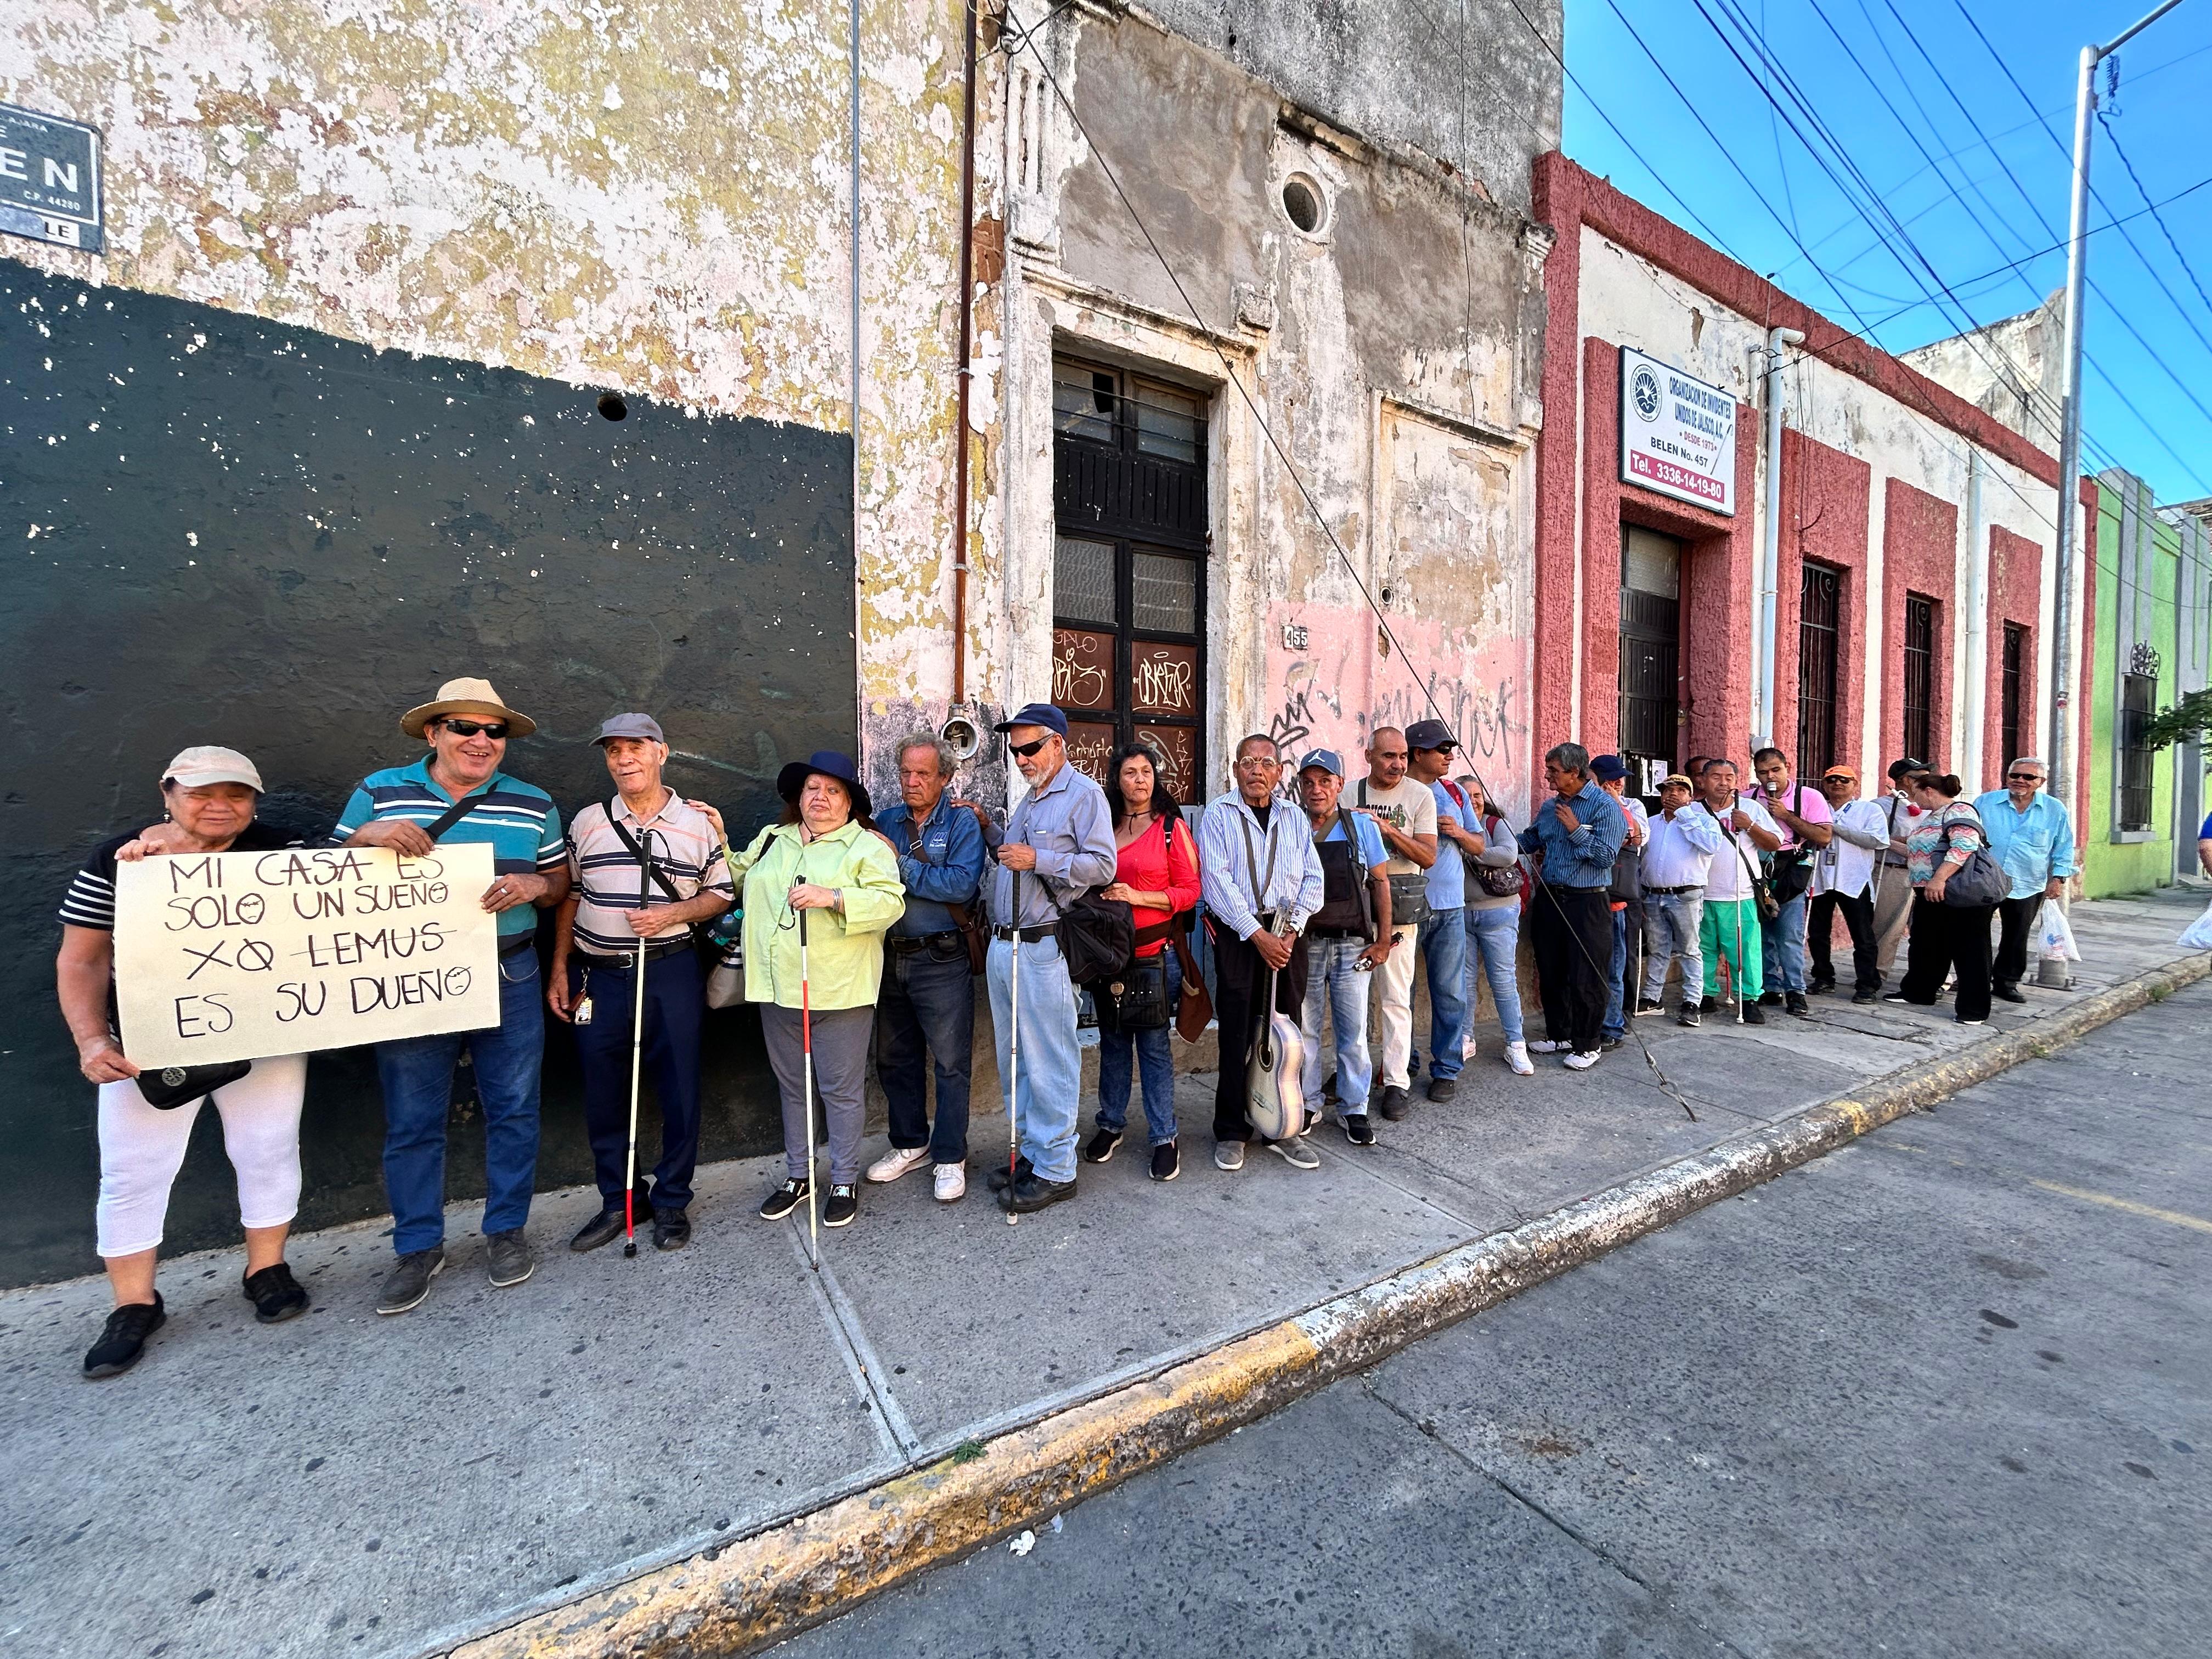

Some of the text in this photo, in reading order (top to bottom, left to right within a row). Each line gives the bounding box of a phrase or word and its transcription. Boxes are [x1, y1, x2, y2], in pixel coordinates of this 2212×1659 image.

[1675, 402, 1690, 426] UNIDOS
[1651, 436, 1708, 467] BELEN No. 457
[1632, 453, 1722, 499] Tel. 3336-14-19-80
[1286, 630, 1307, 646] 455
[170, 857, 222, 893] MI
[256, 850, 374, 886] CASA
[165, 878, 449, 930] SOLO UN SUEÑO
[308, 922, 445, 967] LEMUS
[175, 966, 472, 1039] ES SU DUEÑO
